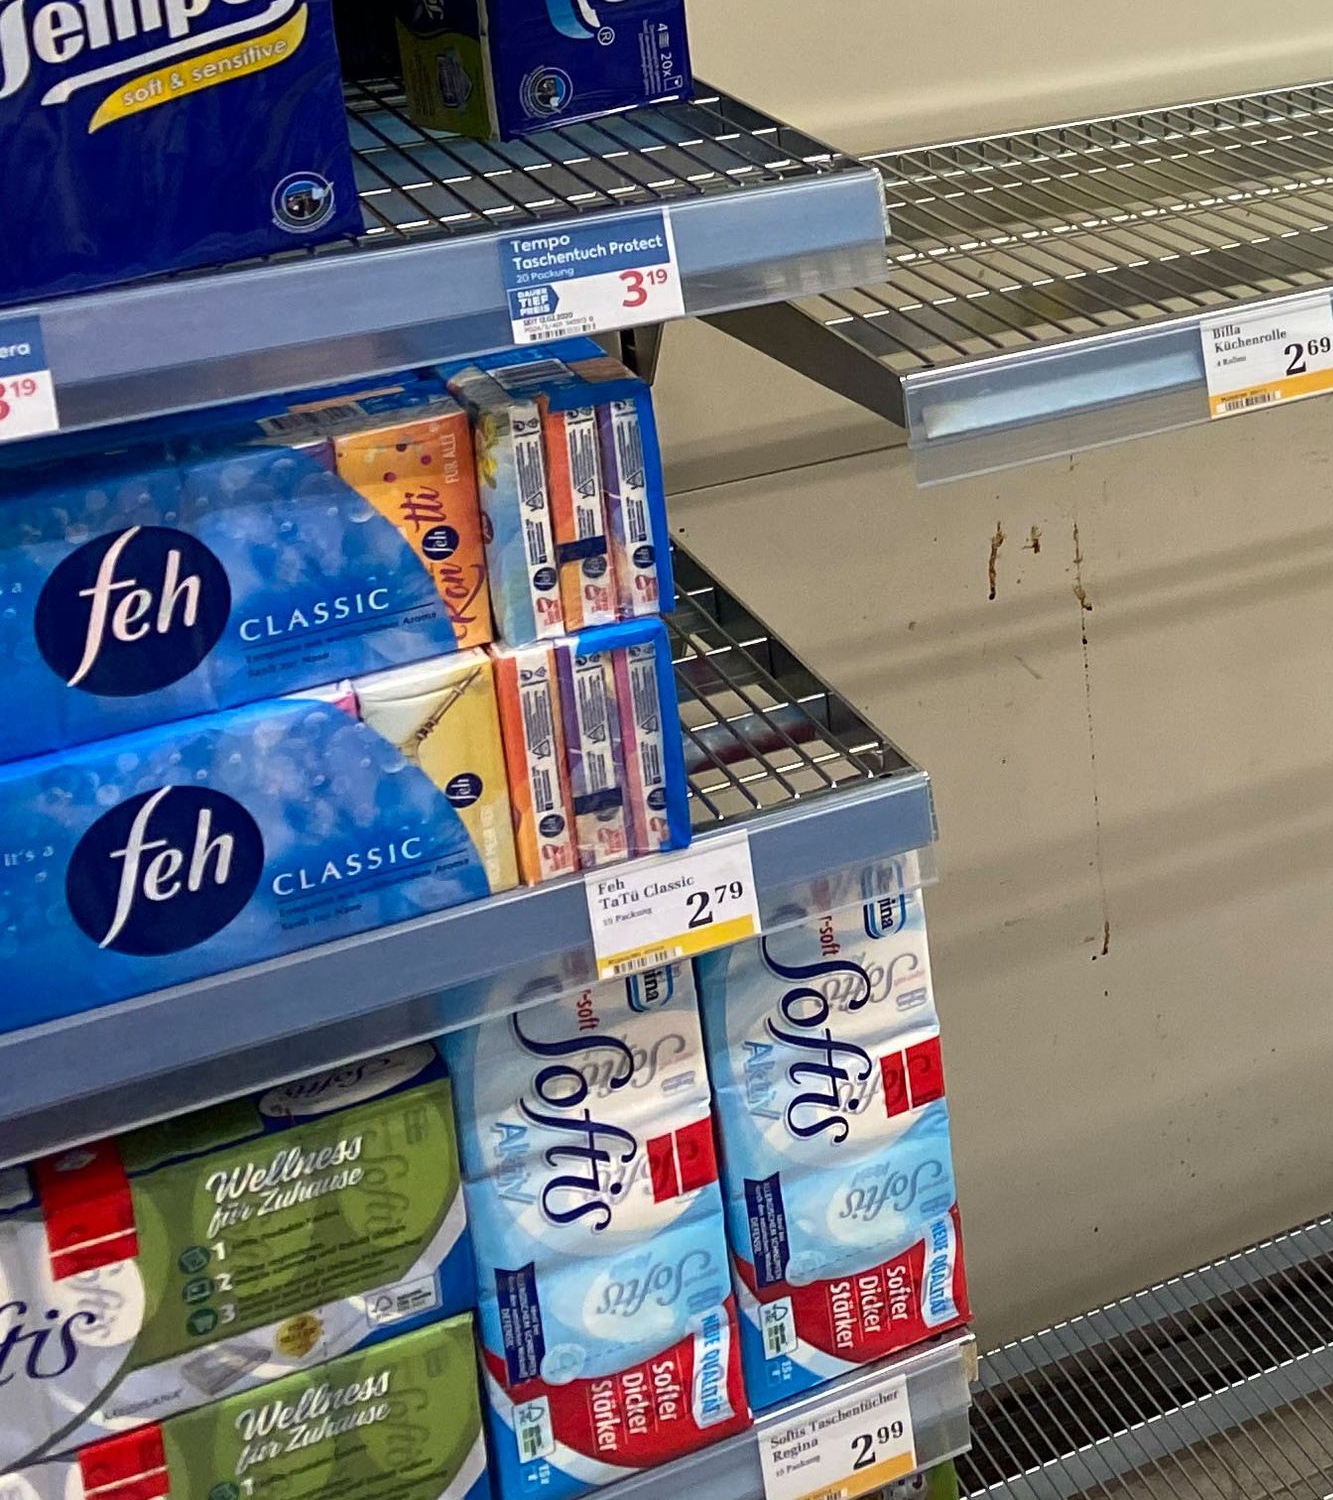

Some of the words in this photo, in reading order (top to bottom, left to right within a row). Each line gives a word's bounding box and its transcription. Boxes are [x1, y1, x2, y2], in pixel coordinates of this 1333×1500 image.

[121, 79, 164, 107] soft
[170, 72, 186, 90] &
[191, 37, 289, 85] sensitive
[510, 235, 571, 253] Tempo
[512, 244, 608, 271] Taschentuch
[609, 234, 664, 255] Protect
[516, 273, 529, 284] 20
[531, 266, 575, 282] Packung
[519, 294, 549, 307] TIEF
[519, 304, 550, 316] PREIS
[1212, 324, 1242, 340] Billa
[1214, 328, 1288, 354] Küchenrolle
[423, 529, 455, 554] feh
[66, 524, 201, 688] feh
[239, 587, 390, 642] CLASSIC
[42, 843, 55, 859] a
[98, 785, 235, 950] feh
[271, 836, 423, 896] CLASSIC
[598, 878, 625, 895] Feh
[599, 892, 640, 910] TaTü
[643, 875, 695, 898] Classic
[615, 906, 653, 922] Packung
[762, 937, 873, 1145] Softis
[511, 1011, 638, 1232] Softis
[205, 1136, 363, 1204] Wellness
[206, 1200, 252, 1240] für
[257, 1167, 365, 1217] Zuhause
[210, 1241, 226, 1261] 1
[930, 1220, 949, 1254] NEUE
[214, 1272, 234, 1293] 2
[886, 1265, 908, 1321] Softer
[220, 1303, 236, 1325] 3
[830, 1281, 855, 1350] Stärker
[858, 1275, 882, 1333] Dicker
[235, 1368, 392, 1442] Wellness
[622, 1371, 649, 1436] Dicker
[652, 1360, 678, 1422] Softer
[590, 1379, 618, 1453] Stärker
[770, 1428, 806, 1450] Softis
[808, 1390, 899, 1434] Taschentücher
[235, 1439, 282, 1476] für
[288, 1403, 392, 1451] Zuhause
[772, 1437, 819, 1464] Regina
[786, 1455, 821, 1474] Packung
[239, 1479, 256, 1498] 1
